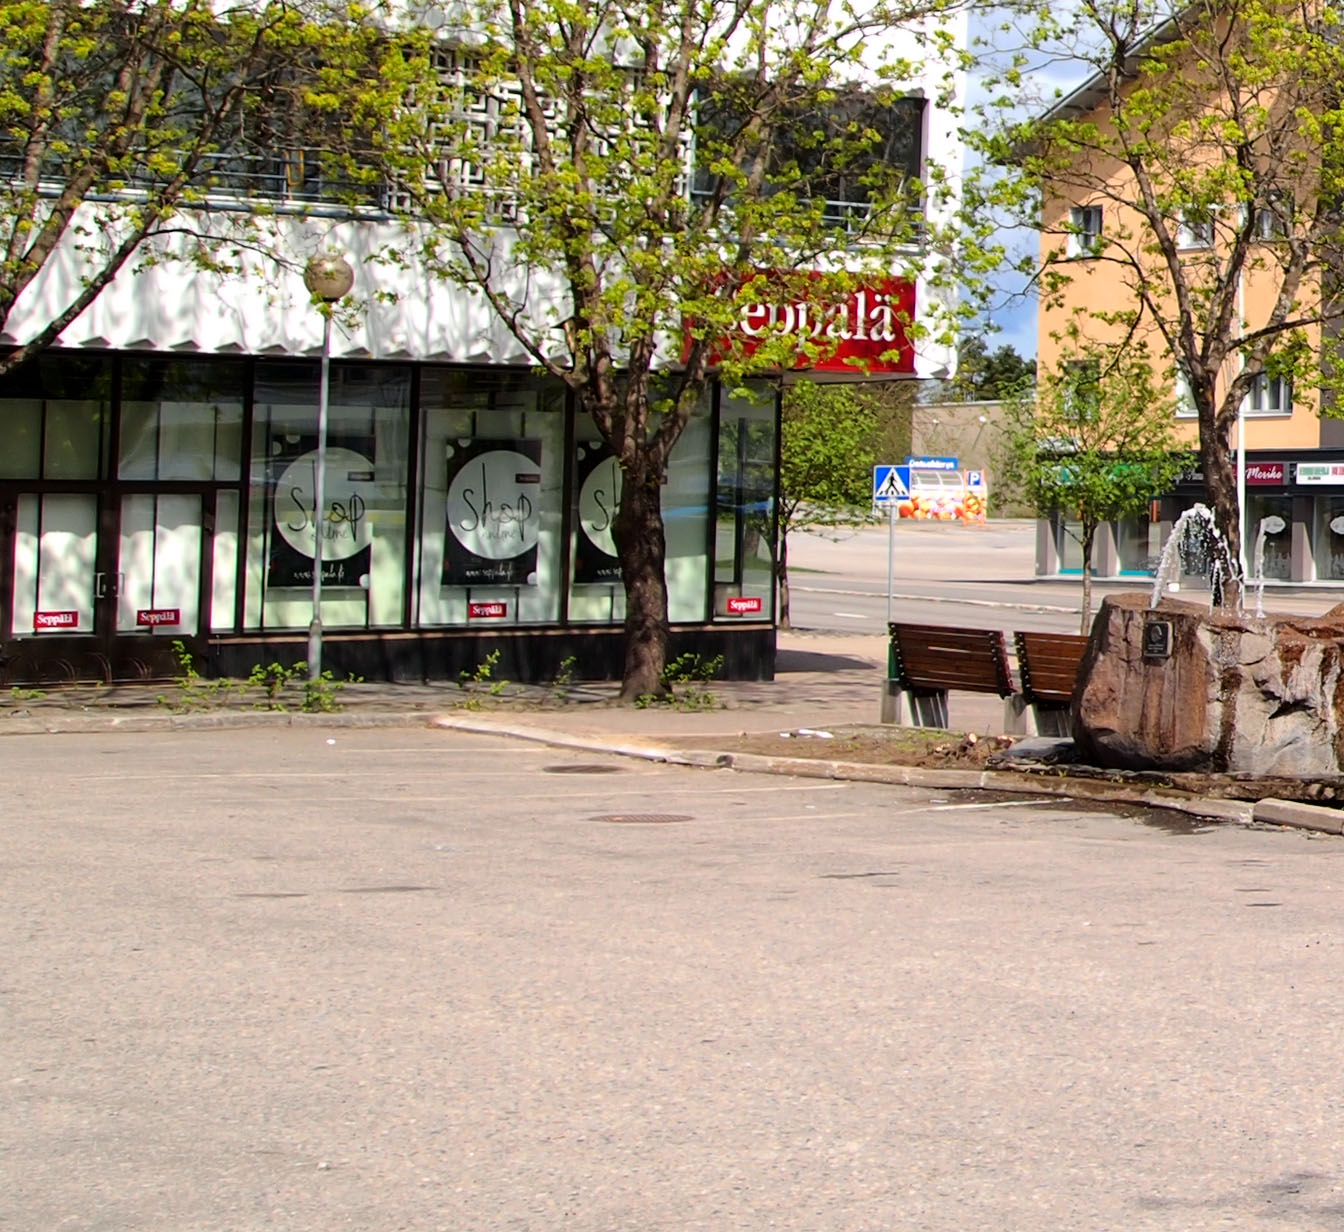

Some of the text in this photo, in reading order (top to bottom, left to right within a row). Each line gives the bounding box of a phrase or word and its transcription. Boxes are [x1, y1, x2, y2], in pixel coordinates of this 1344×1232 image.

[714, 289, 896, 353] eppälä
[472, 605, 503, 617] Seppälä
[730, 599, 757, 611] Seppälä
[37, 613, 73, 626] Seppälä
[141, 611, 175, 623] Seppälä
